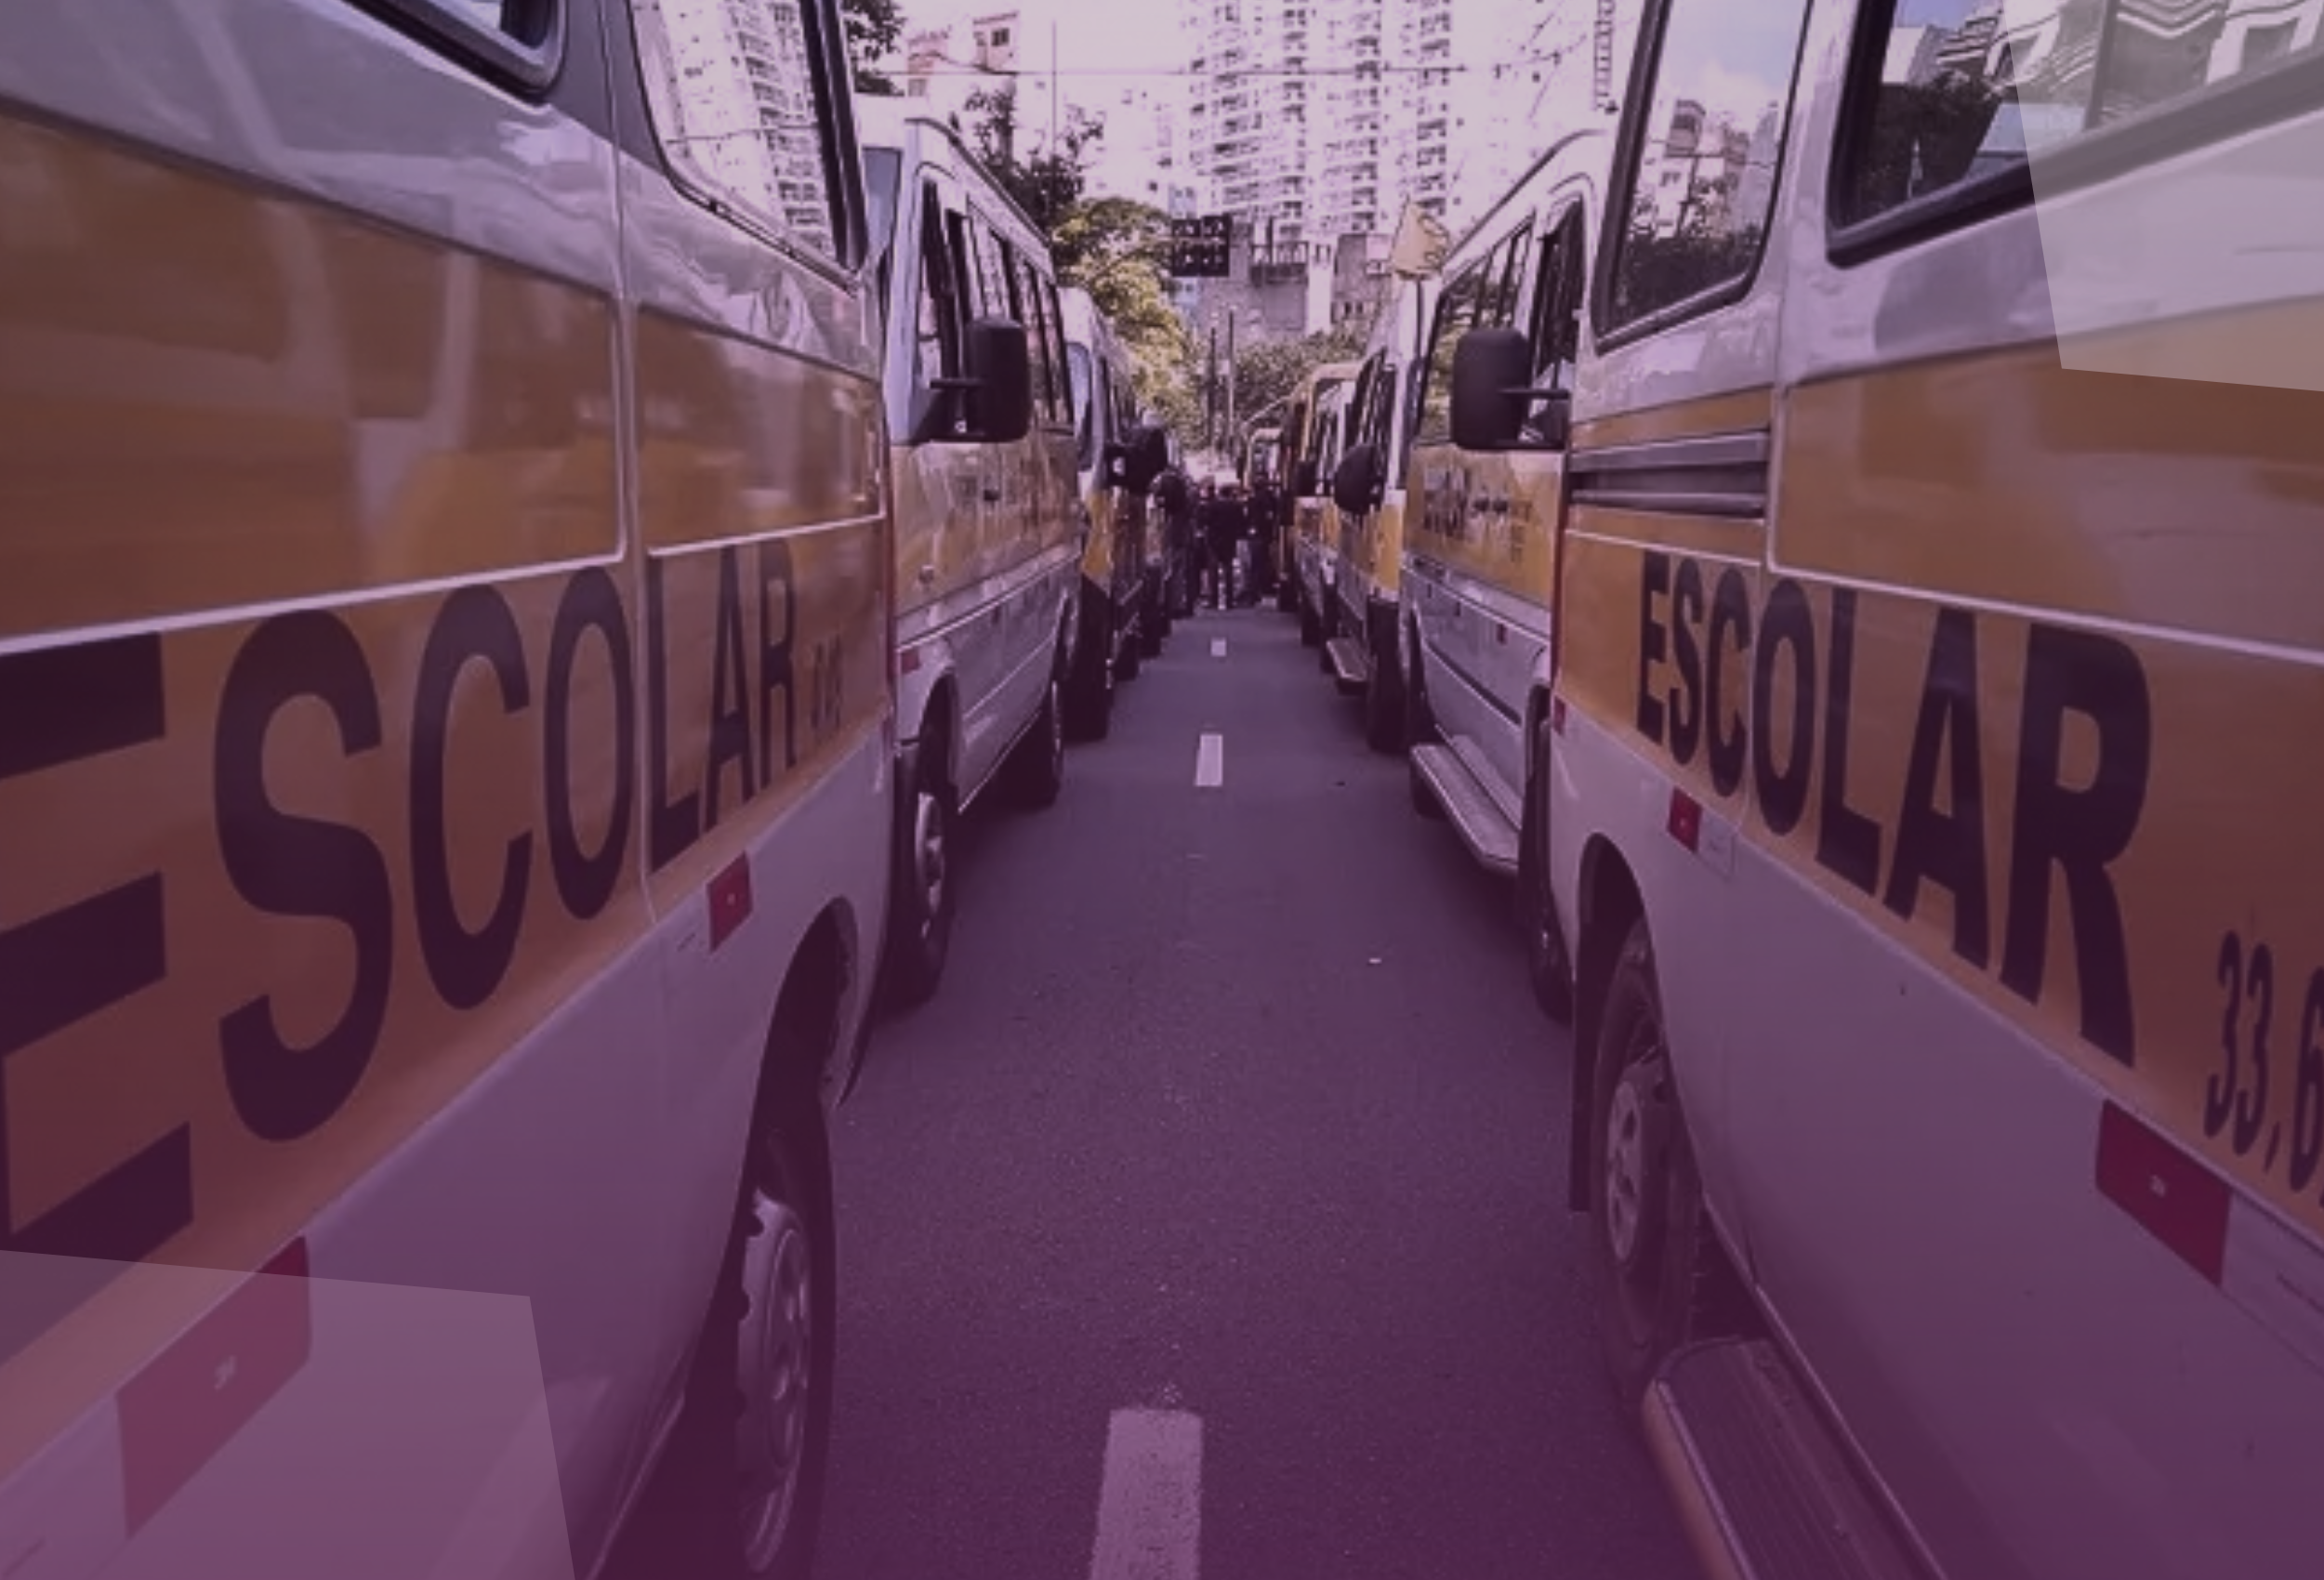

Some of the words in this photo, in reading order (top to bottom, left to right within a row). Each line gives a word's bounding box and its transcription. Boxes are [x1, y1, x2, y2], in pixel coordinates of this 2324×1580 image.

[0, 535, 798, 1366] ESCOLAR
[1636, 549, 2152, 1069] ESCOLAR
[2203, 930, 2324, 1209] 33,6
